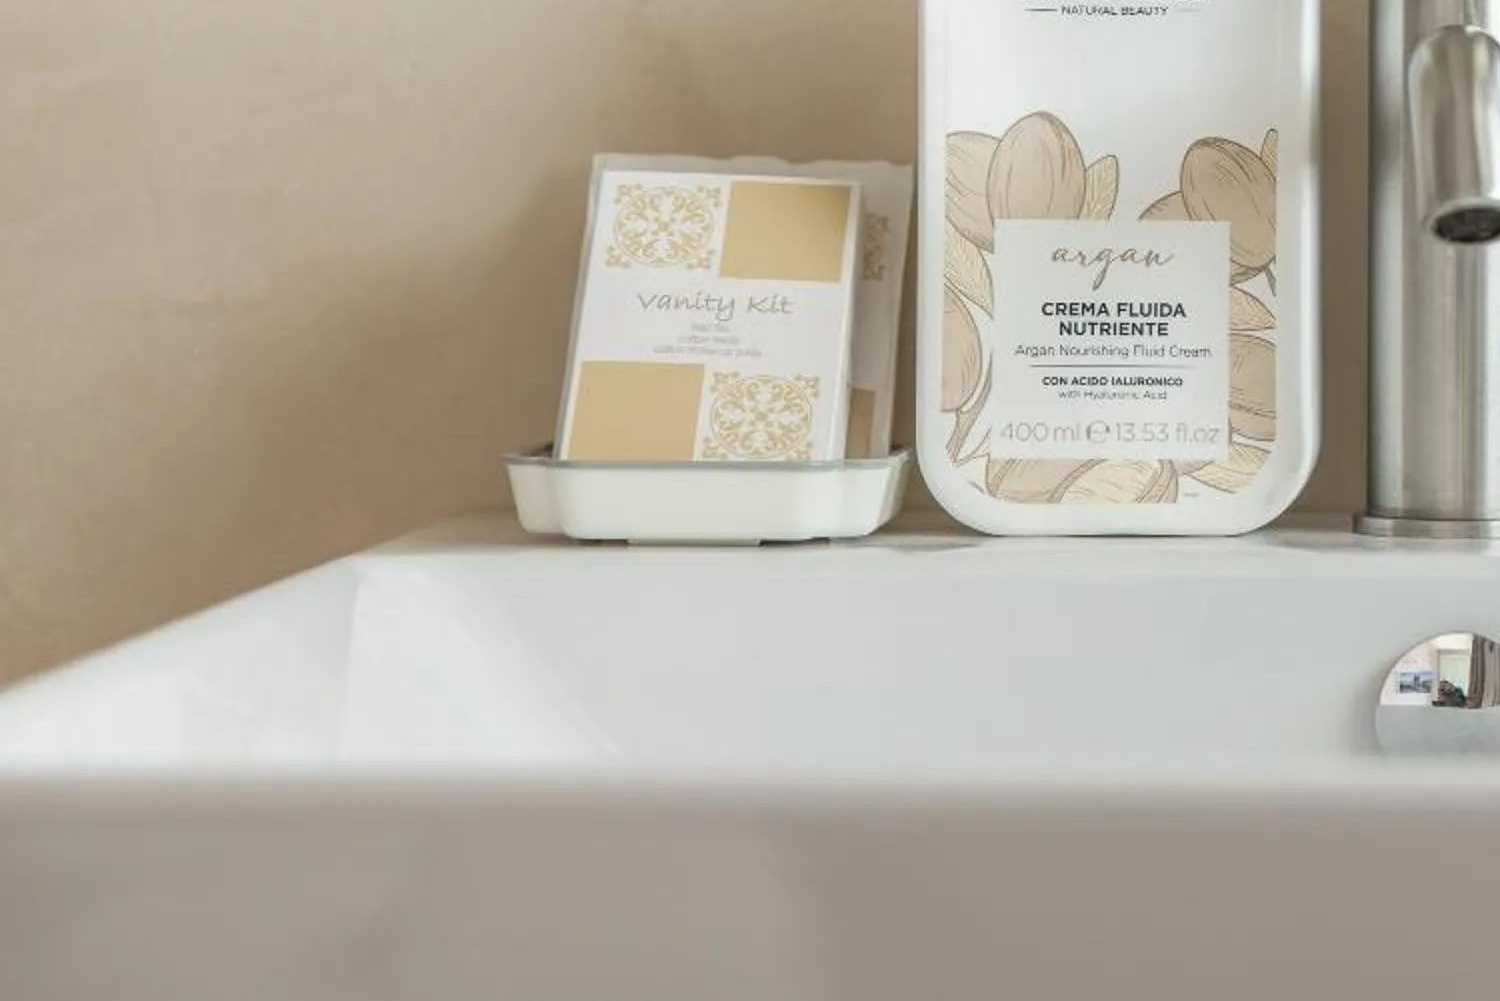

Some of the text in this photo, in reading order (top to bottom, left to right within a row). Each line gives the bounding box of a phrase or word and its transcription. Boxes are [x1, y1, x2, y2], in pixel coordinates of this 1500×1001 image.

[1061, 6, 1169, 16] NATURAL BEAUTY
[1050, 247, 1175, 291] argan
[747, 293, 796, 314] Kit
[1041, 302, 1187, 318] CREMA FLUIDA
[1059, 322, 1169, 336] NUTRIENTE
[1014, 344, 1212, 358] Argan Nourishing Fluid Cream
[1041, 376, 1183, 387] CON ACIDO IALURONICO
[999, 422, 1049, 443] 400
[1053, 422, 1080, 442] ml
[1115, 422, 1170, 443] 13.53
